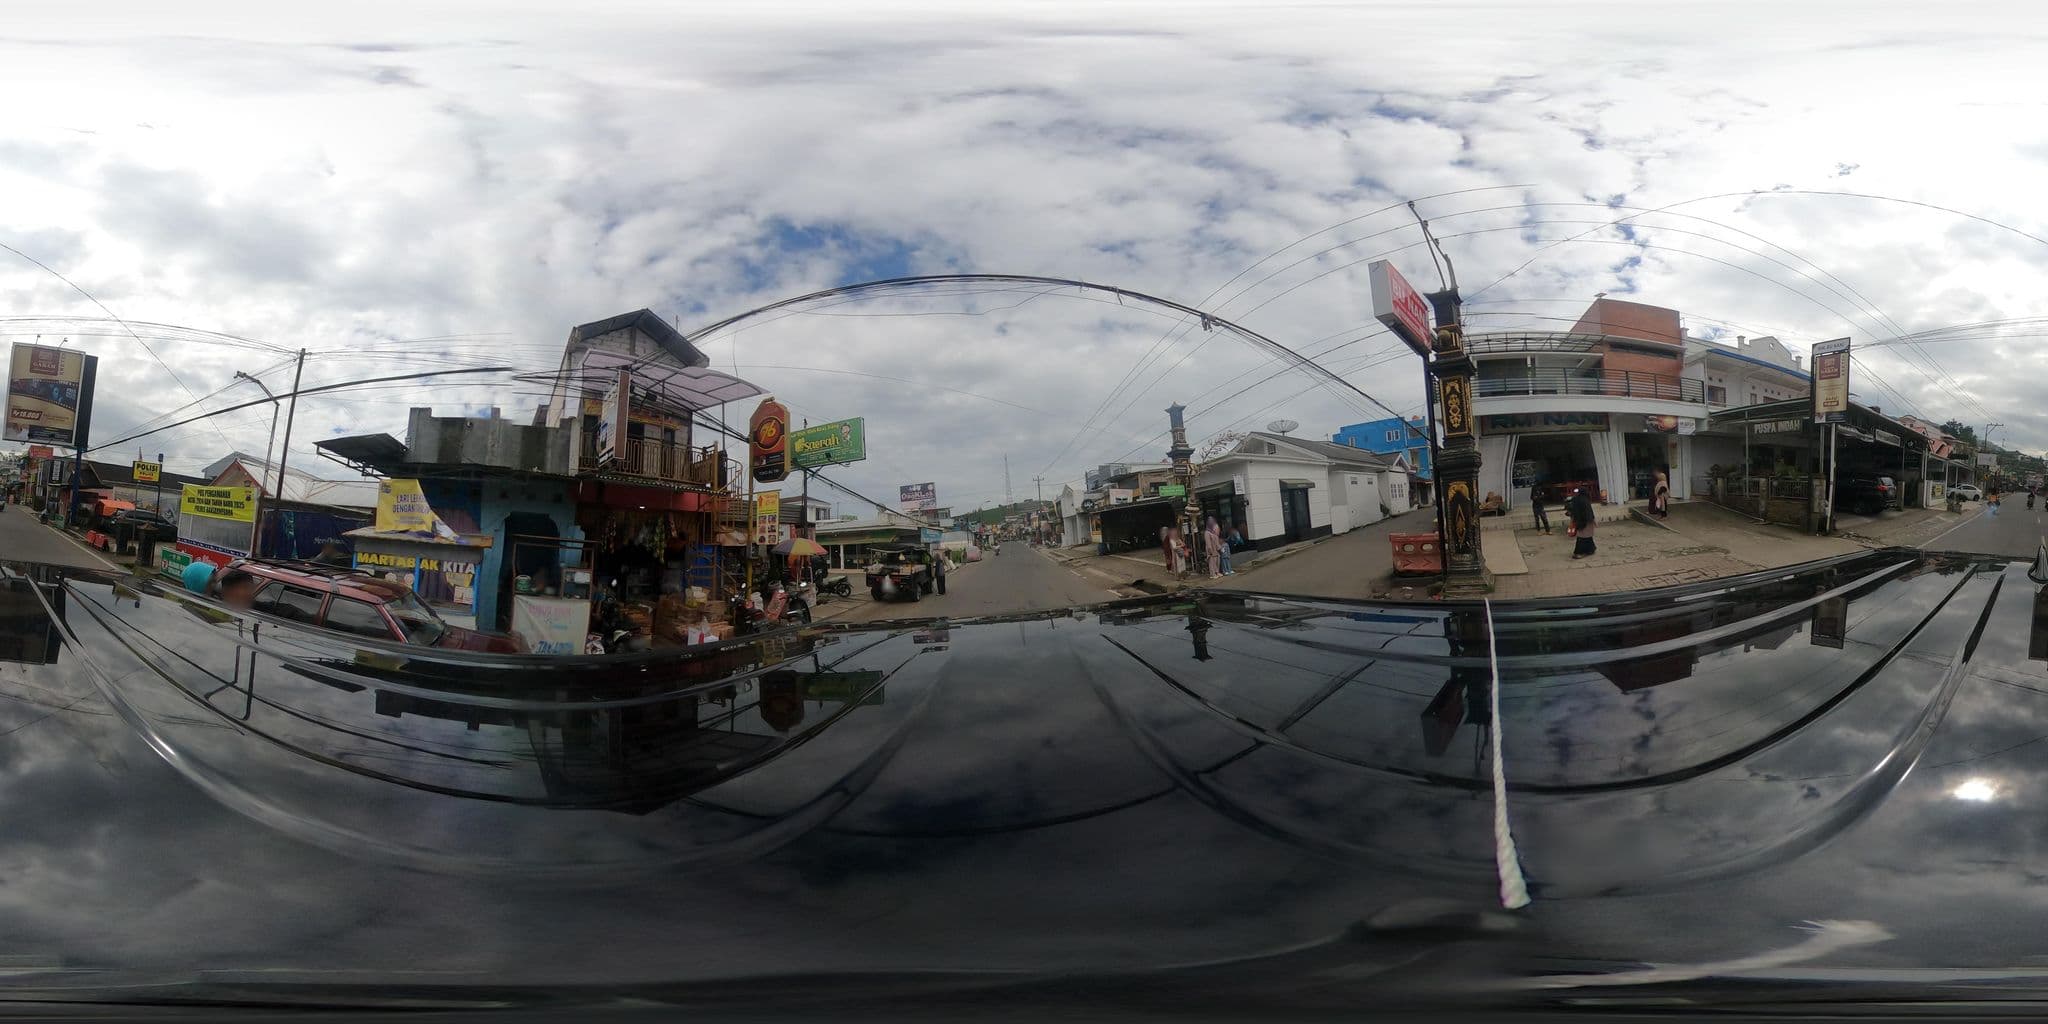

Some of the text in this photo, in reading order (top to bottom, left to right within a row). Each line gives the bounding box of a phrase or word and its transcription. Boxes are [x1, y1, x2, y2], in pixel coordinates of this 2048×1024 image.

[1754, 421, 1777, 434] PUSPA
[136, 463, 158, 473] POLISI
[443, 561, 475, 574] KITA
